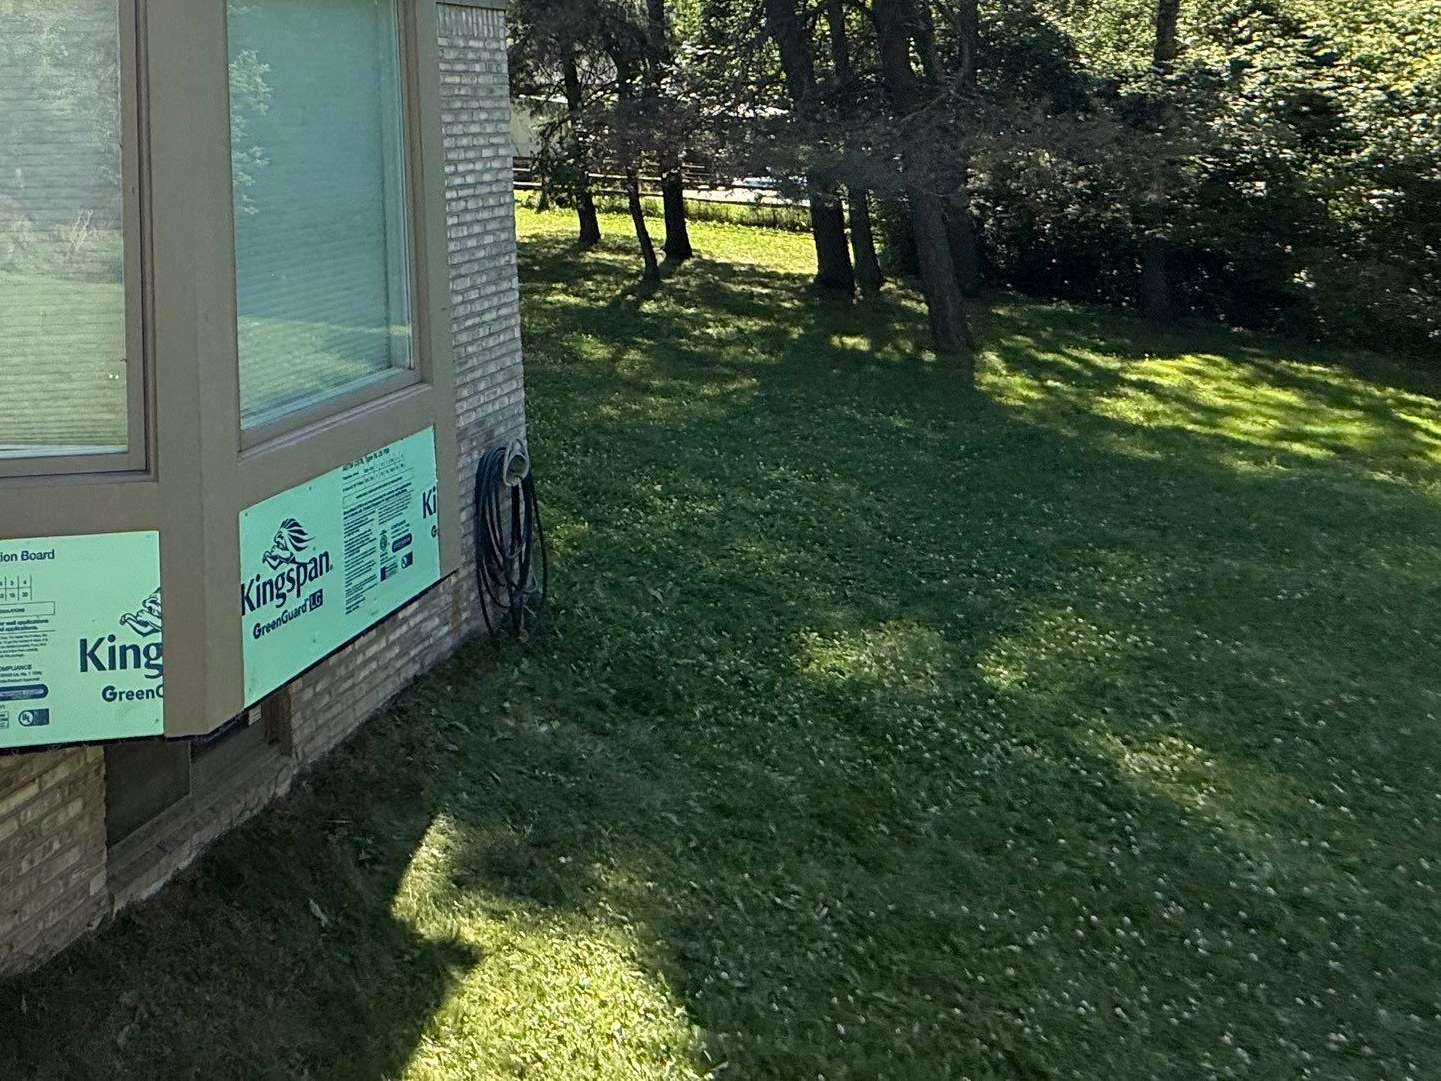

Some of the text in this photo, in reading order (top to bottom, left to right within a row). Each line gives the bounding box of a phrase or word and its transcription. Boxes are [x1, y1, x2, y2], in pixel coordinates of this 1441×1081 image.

[21, 550, 55, 561] Board
[241, 551, 330, 616] Kingspan
[253, 590, 323, 639] GreenGuard LG
[79, 634, 163, 679] King
